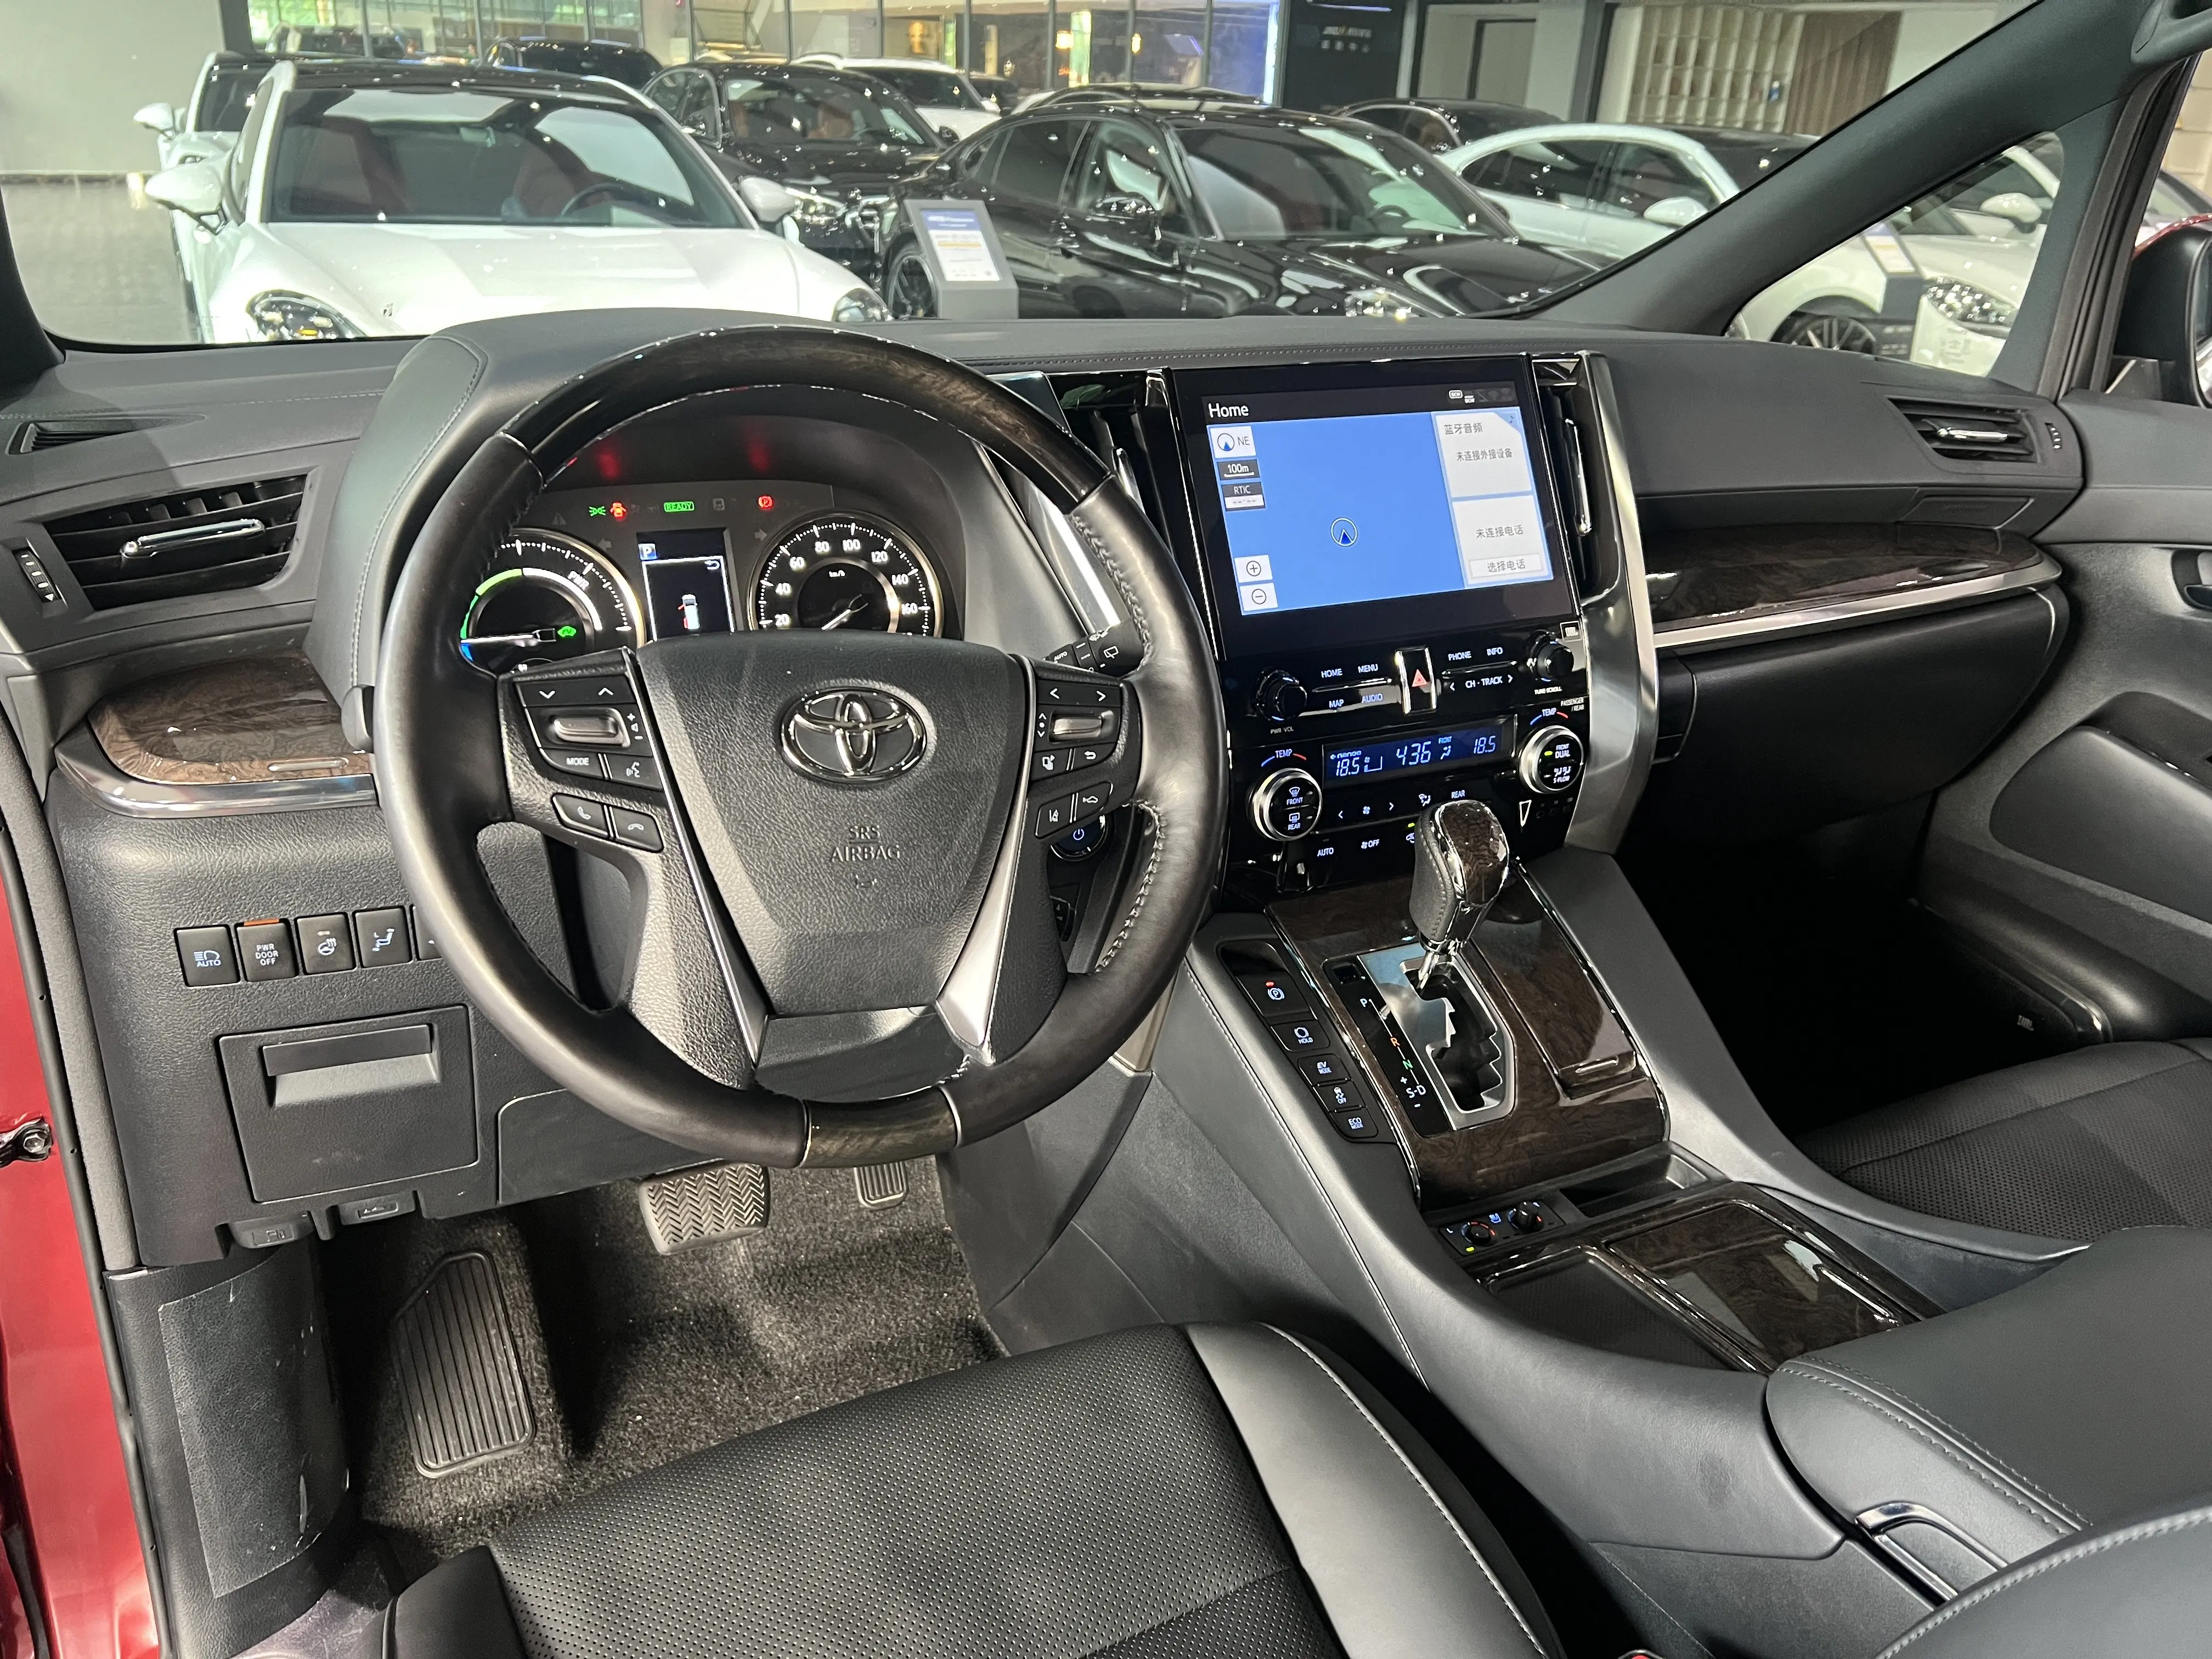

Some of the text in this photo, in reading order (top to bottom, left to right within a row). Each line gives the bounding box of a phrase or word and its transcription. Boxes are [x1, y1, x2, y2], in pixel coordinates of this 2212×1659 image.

[1208, 403, 1249, 418] Home
[1444, 422, 1483, 435] 蓝牙音频
[1237, 436, 1250, 446] NE
[1457, 448, 1513, 461] 未连接外接设备
[1227, 463, 1249, 474] 100m
[1233, 485, 1251, 495] RTIC
[665, 503, 692, 511] READY
[1476, 524, 1523, 538] 未连接电话
[815, 541, 830, 552] 80
[843, 539, 861, 551] 100
[642, 545, 652, 558] P
[871, 551, 888, 563] 120
[789, 556, 805, 569] 60
[1487, 559, 1525, 573] 选择电话
[891, 574, 909, 585] 140
[775, 583, 791, 595] 40
[901, 603, 918, 615] 160
[775, 613, 790, 626] 20
[1054, 651, 1068, 661] AUTO
[1448, 647, 1503, 661] PHONE INFO
[1321, 663, 1378, 678] HOME MENU
[1329, 693, 1383, 708] MAP AUDIO
[1542, 707, 1558, 717] TEMP
[1473, 735, 1496, 754] 18.5
[1275, 748, 1293, 758] TEMP
[1396, 741, 1431, 766] 436
[1555, 750, 1571, 759] DUAL
[566, 757, 590, 766] MODE
[1336, 757, 1359, 776] 18.5
[1451, 789, 1465, 799] REAR
[1286, 797, 1303, 805] FRONT
[849, 825, 881, 840] SRS
[1368, 839, 1380, 848] OFF
[831, 844, 900, 862] AIRBAG
[1317, 847, 1334, 856] AUTO
[256, 943, 275, 951] PWR
[255, 950, 279, 960] DOOR
[259, 957, 276, 966] OFF
[1360, 997, 1368, 1007] P
[1390, 1037, 1401, 1047] R
[1402, 1059, 1413, 1070] N
